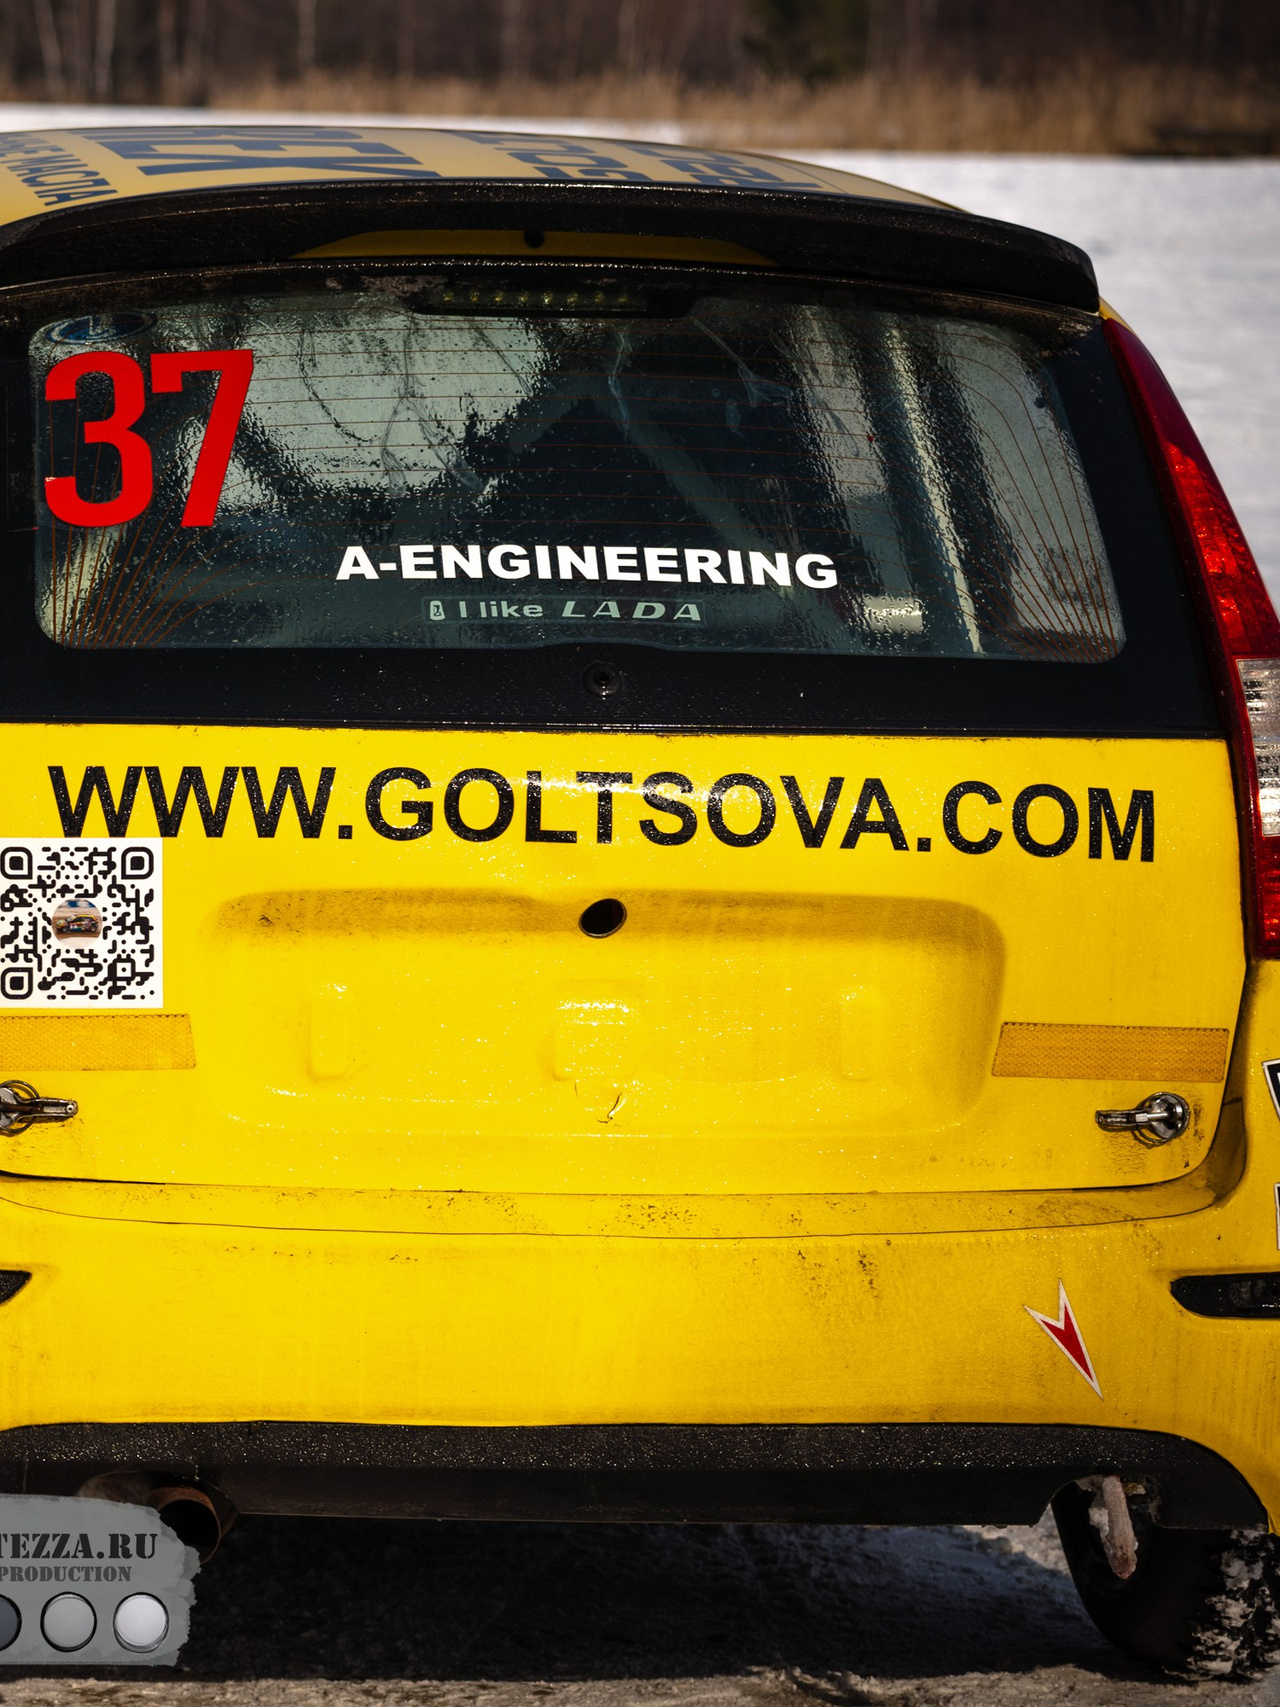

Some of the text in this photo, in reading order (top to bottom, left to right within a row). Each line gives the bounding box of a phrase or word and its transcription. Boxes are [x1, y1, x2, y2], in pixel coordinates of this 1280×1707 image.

[44, 349, 255, 528] 37
[335, 544, 838, 589] A-ENGINEERING
[480, 602, 543, 619] like
[562, 601, 701, 621] LADA
[48, 764, 1156, 864] WWW.GOLTSOVA.COM
